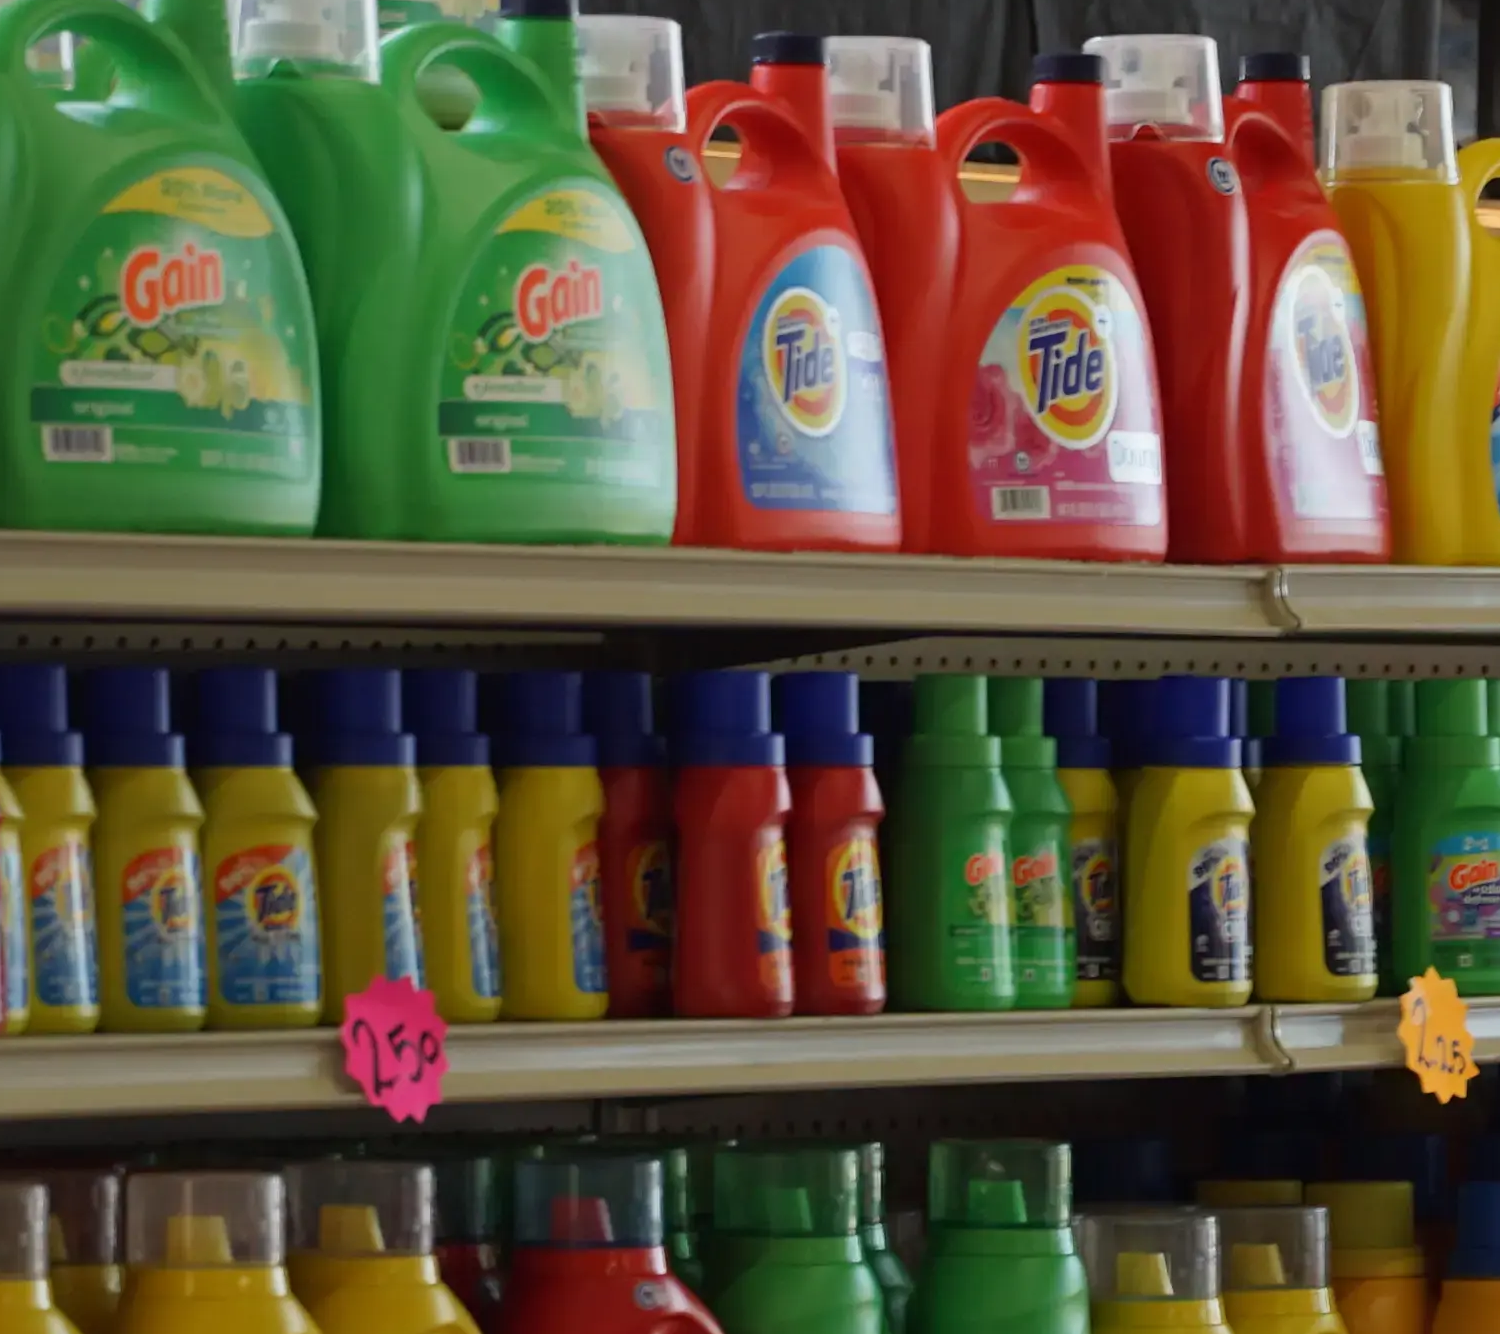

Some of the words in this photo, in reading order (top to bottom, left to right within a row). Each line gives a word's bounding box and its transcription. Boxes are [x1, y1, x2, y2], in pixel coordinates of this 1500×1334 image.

[122, 243, 223, 325] Gain
[516, 259, 602, 341] Gain
[776, 328, 837, 405] Tide
[1028, 330, 1105, 415] Tide
[254, 884, 296, 925] Tide
[964, 852, 1004, 887] Ga
[1447, 860, 1500, 892] Gain
